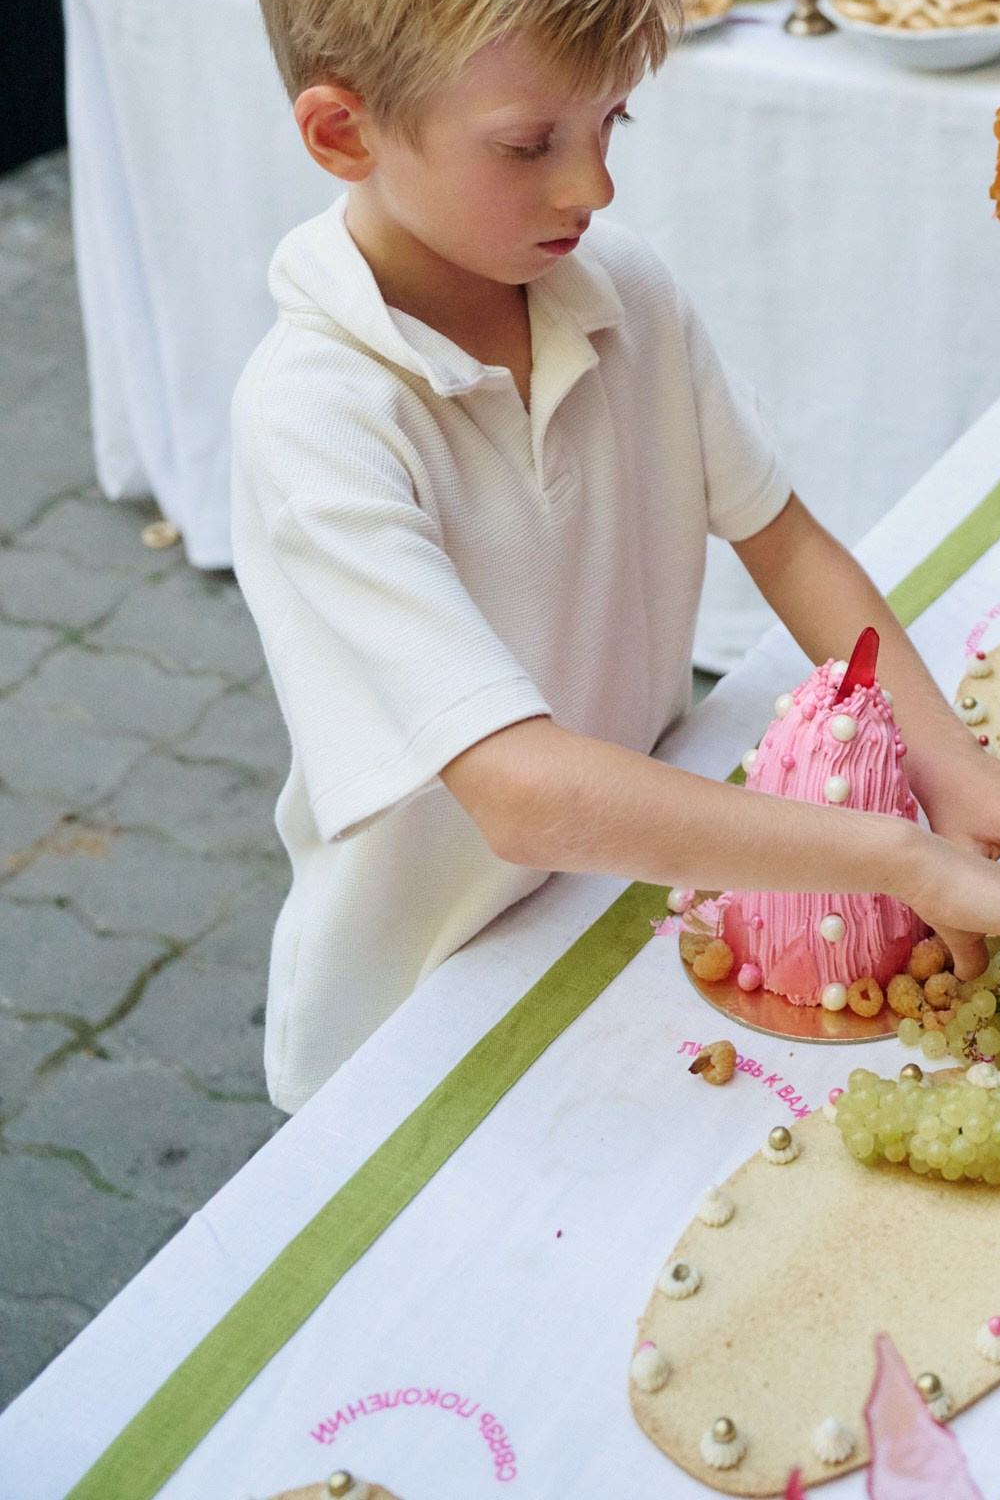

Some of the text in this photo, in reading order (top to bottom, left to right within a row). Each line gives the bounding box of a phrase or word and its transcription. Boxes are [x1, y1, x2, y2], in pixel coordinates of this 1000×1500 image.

[762, 1073, 783, 1088] К
[309, 1387, 517, 1483] СВЯЗЬ ПОКОЛЕНИЙ
